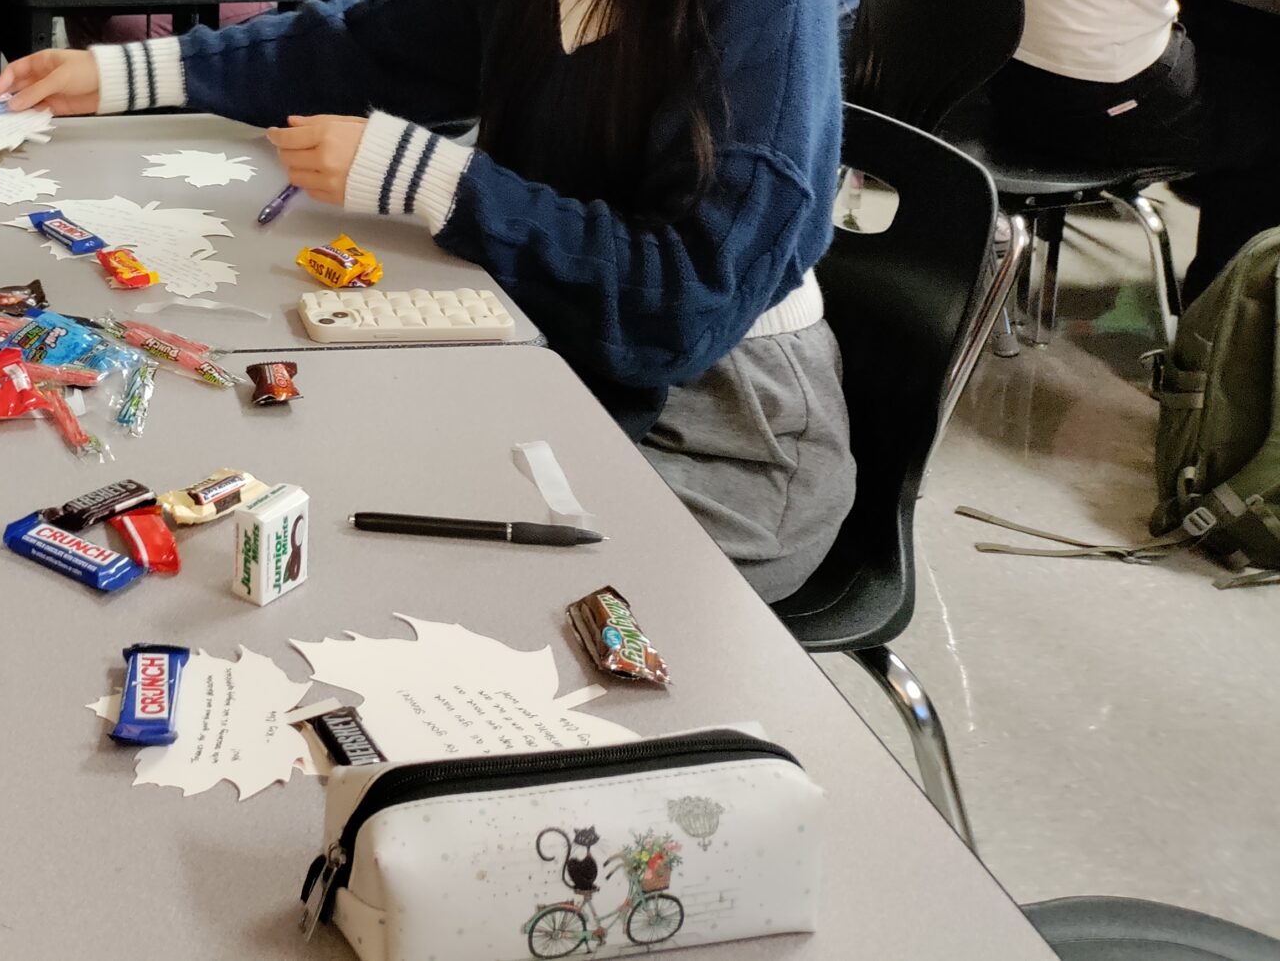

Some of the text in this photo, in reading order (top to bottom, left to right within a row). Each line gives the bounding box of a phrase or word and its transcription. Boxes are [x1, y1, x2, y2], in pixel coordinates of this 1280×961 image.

[50, 219, 89, 240] CRUNCH
[145, 338, 180, 359] PUNCH
[36, 527, 115, 562] CRUNCH
[251, 523, 261, 565] Mints
[241, 529, 254, 596] Junior
[273, 532, 283, 594] Junior
[140, 656, 166, 716] CRUNCH
[434, 694, 456, 712] have
[466, 698, 486, 716] have
[422, 719, 448, 737] your
